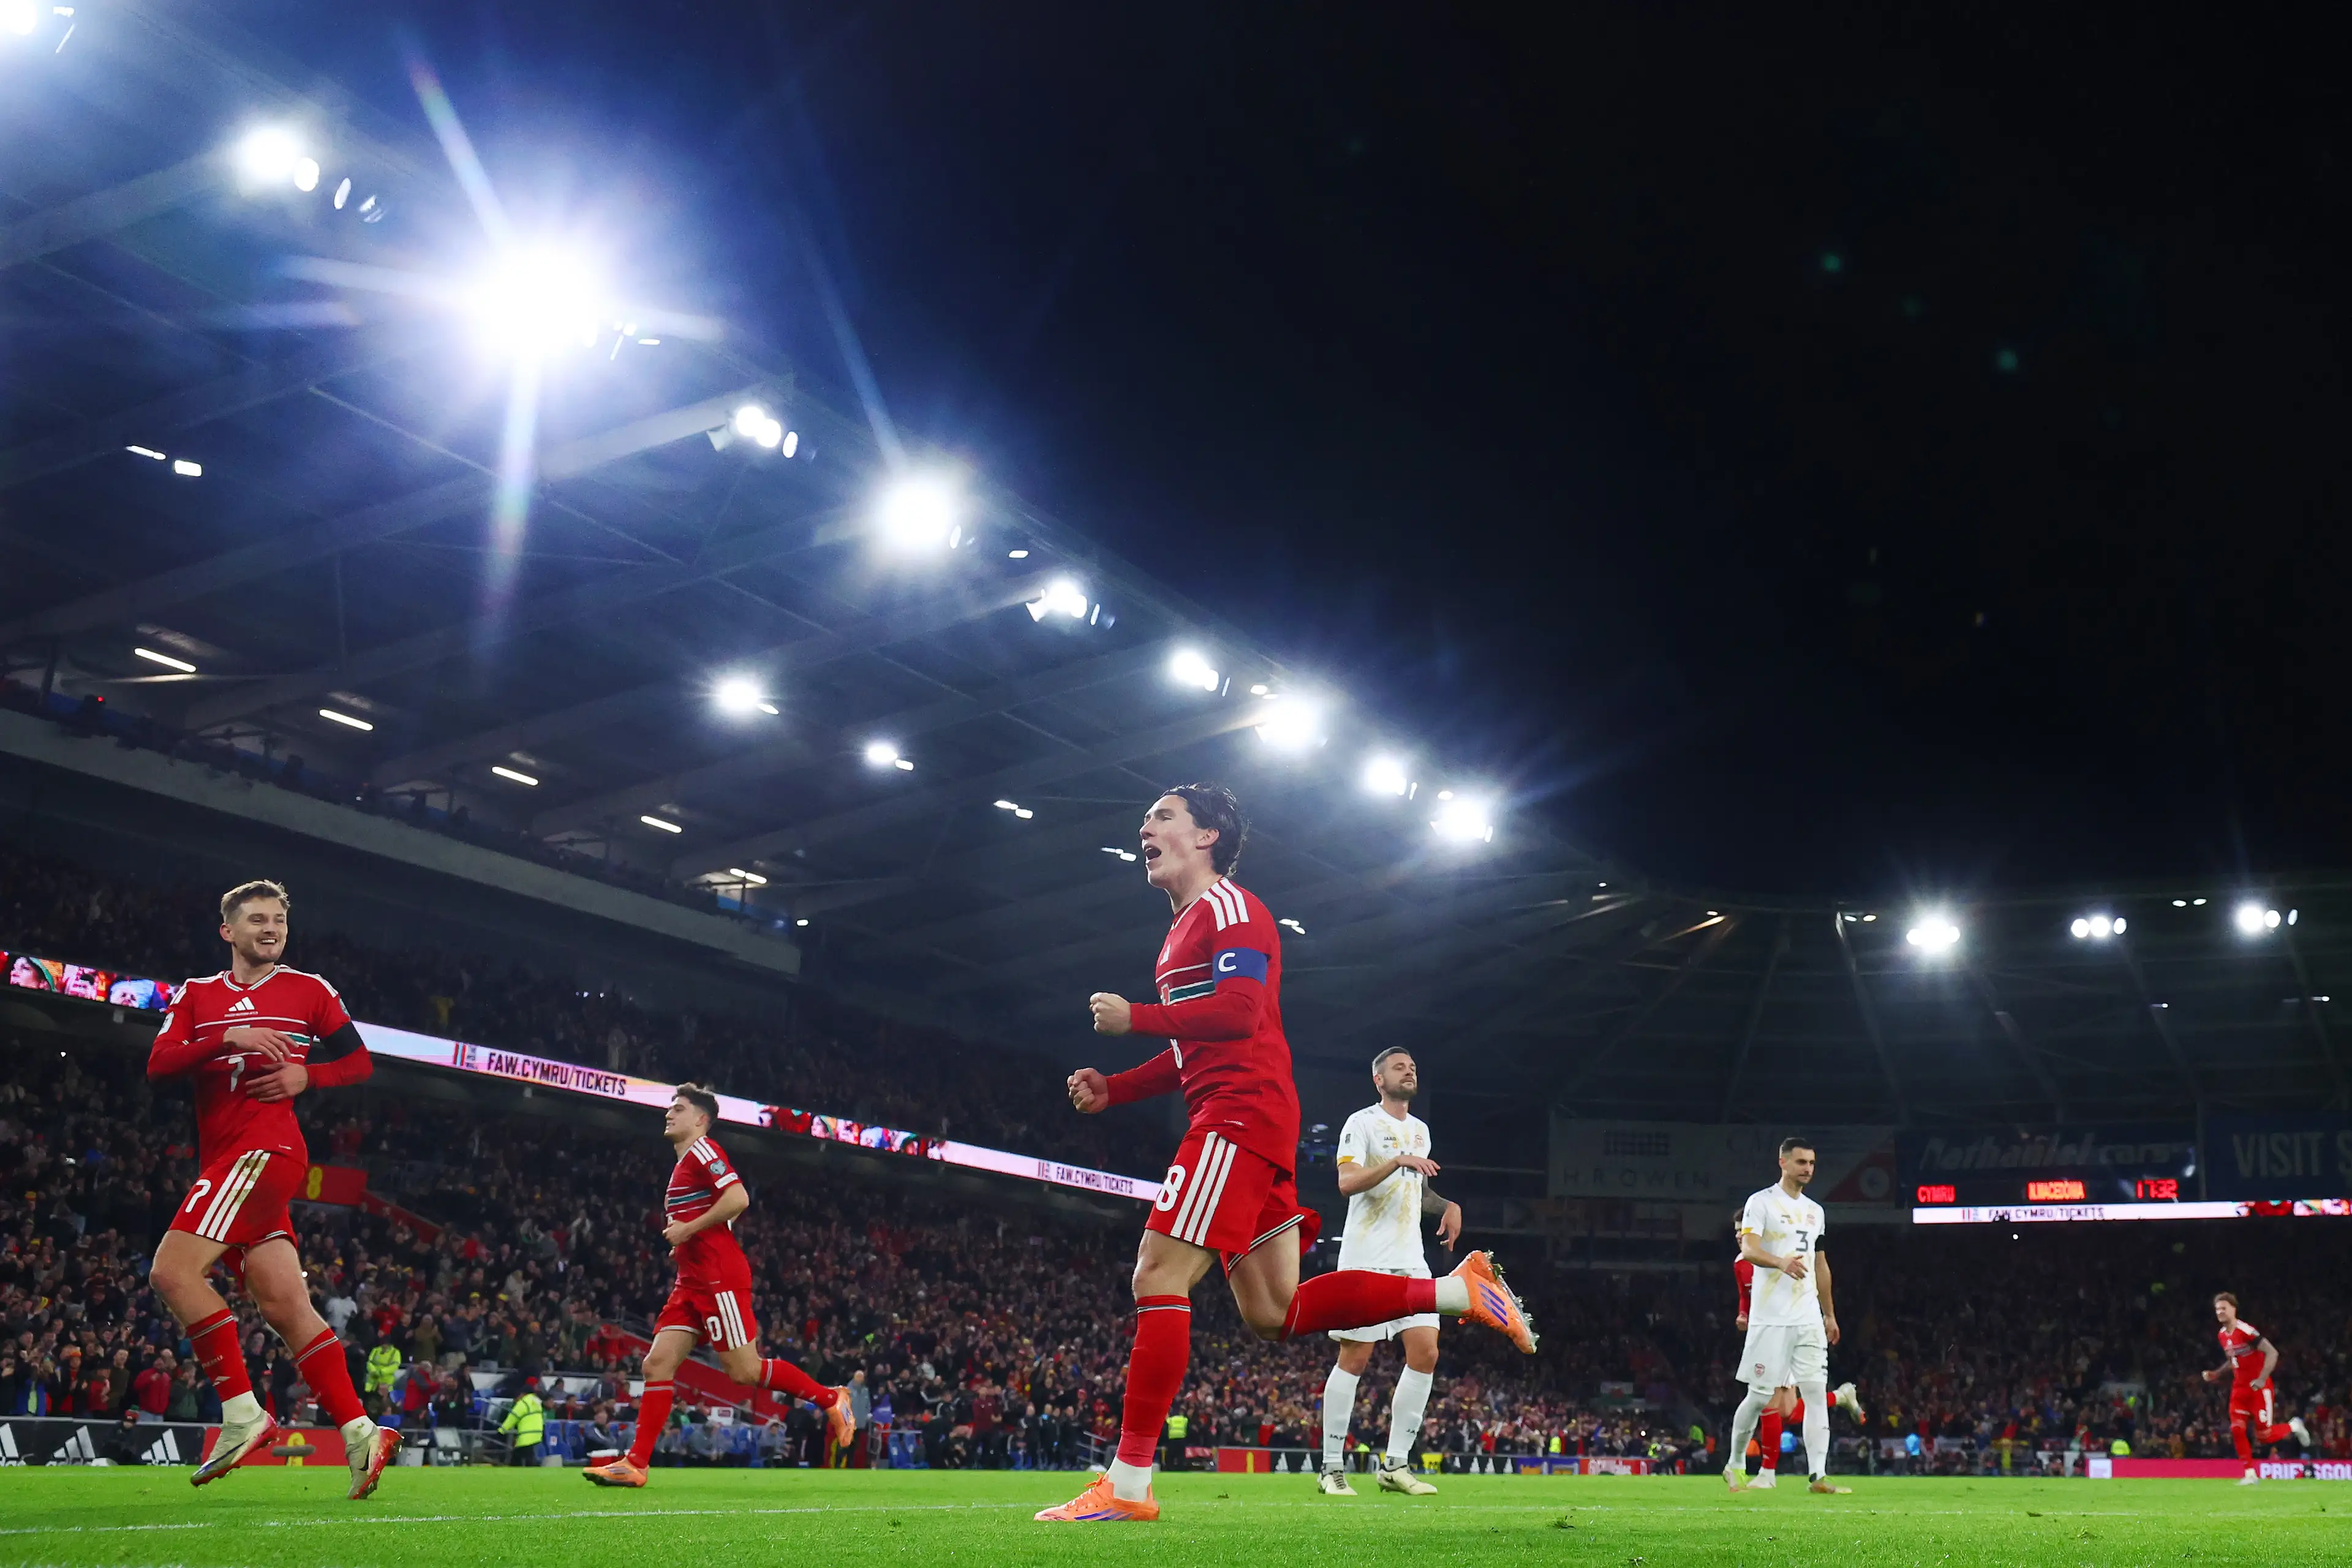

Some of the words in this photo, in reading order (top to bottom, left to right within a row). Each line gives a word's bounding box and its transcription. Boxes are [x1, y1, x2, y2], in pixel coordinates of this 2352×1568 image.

[1218, 952, 1237, 972] C
[228, 1057, 244, 1092] 7
[488, 1052, 627, 1096] FAW.CYMRU/TICKETS
[2233, 1132, 2323, 1178] VISIT
[185, 1179, 211, 1213] 7
[1156, 1165, 1186, 1212] 8
[1917, 1185, 1955, 1203] CYMRU
[1989, 1207, 2104, 1220] FAWCYMRU/TICKETS
[1795, 1229, 1809, 1252] 3
[2260, 1462, 2352, 1480] PRIFSGOL
